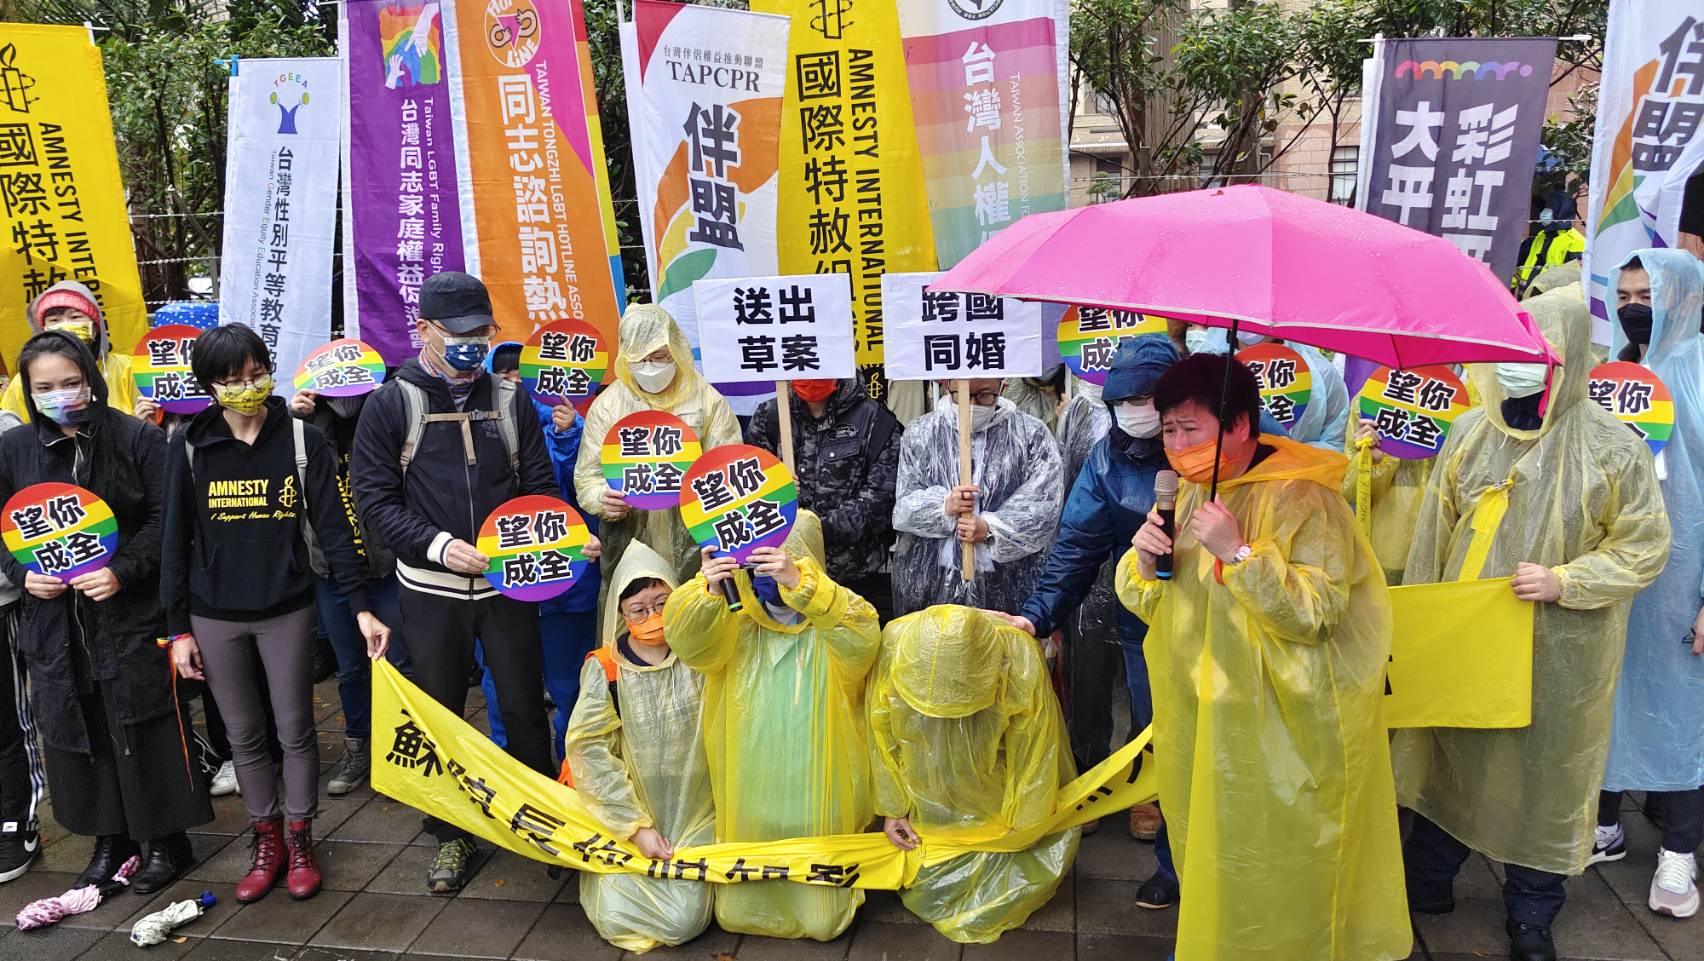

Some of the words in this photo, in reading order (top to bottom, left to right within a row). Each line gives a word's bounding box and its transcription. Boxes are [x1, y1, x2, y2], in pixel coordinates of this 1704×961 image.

[664, 45, 764, 69] 台灣伴侶權益推動聯盟
[666, 60, 761, 93] TAPCPR
[273, 72, 309, 89] TGEEA
[536, 60, 553, 118] TAIWAN
[1009, 72, 1024, 123] TAIWAN
[424, 97, 434, 147] Taiwan
[848, 48, 880, 159] AMNESTY
[542, 119, 562, 182] TONGZHI
[962, 41, 1011, 246] 台灣人權
[1382, 100, 1446, 226] 大平
[38, 122, 84, 223] AMNESTY
[268, 148, 277, 180] Taiwan
[427, 150, 439, 190] LGBT
[682, 101, 745, 252] 伴盟
[1014, 125, 1030, 203] ASSOCIATION
[263, 181, 275, 215] Gender
[429, 193, 443, 239] Family
[497, 74, 568, 334] 同志諮詢熱
[550, 185, 567, 221] LGBT
[795, 50, 860, 353] 國際特赦
[256, 216, 271, 245] Equity
[251, 246, 267, 292] Education
[430, 243, 444, 274] Righ
[557, 223, 577, 283] HOTLINE
[855, 167, 886, 352] INTERNATIONAL
[567, 285, 584, 320] ASSO
[733, 284, 817, 326] 送出
[921, 284, 1004, 322] 跨國
[539, 332, 597, 362] 望你
[737, 333, 821, 373] 草案
[923, 331, 1006, 372] 同婚
[1081, 336, 1140, 370] 成
[154, 373, 210, 399] 成全
[315, 365, 373, 388] 成全
[536, 367, 591, 395] 成全
[1383, 370, 1456, 411] 望你
[1259, 395, 1294, 421] 全
[620, 427, 682, 456] 望你
[1375, 409, 1442, 448] 成全
[207, 479, 269, 497] AMNESTY
[623, 463, 683, 493] 成全
[694, 457, 767, 511] 望你
[13, 496, 86, 540] 望你
[207, 496, 269, 509] INTERNATIONAL
[217, 512, 247, 523] Support
[248, 511, 271, 519] Human
[498, 511, 567, 548] 望你
[714, 499, 785, 551] 成全
[35, 530, 105, 574] 成全
[504, 550, 572, 586] 成全
